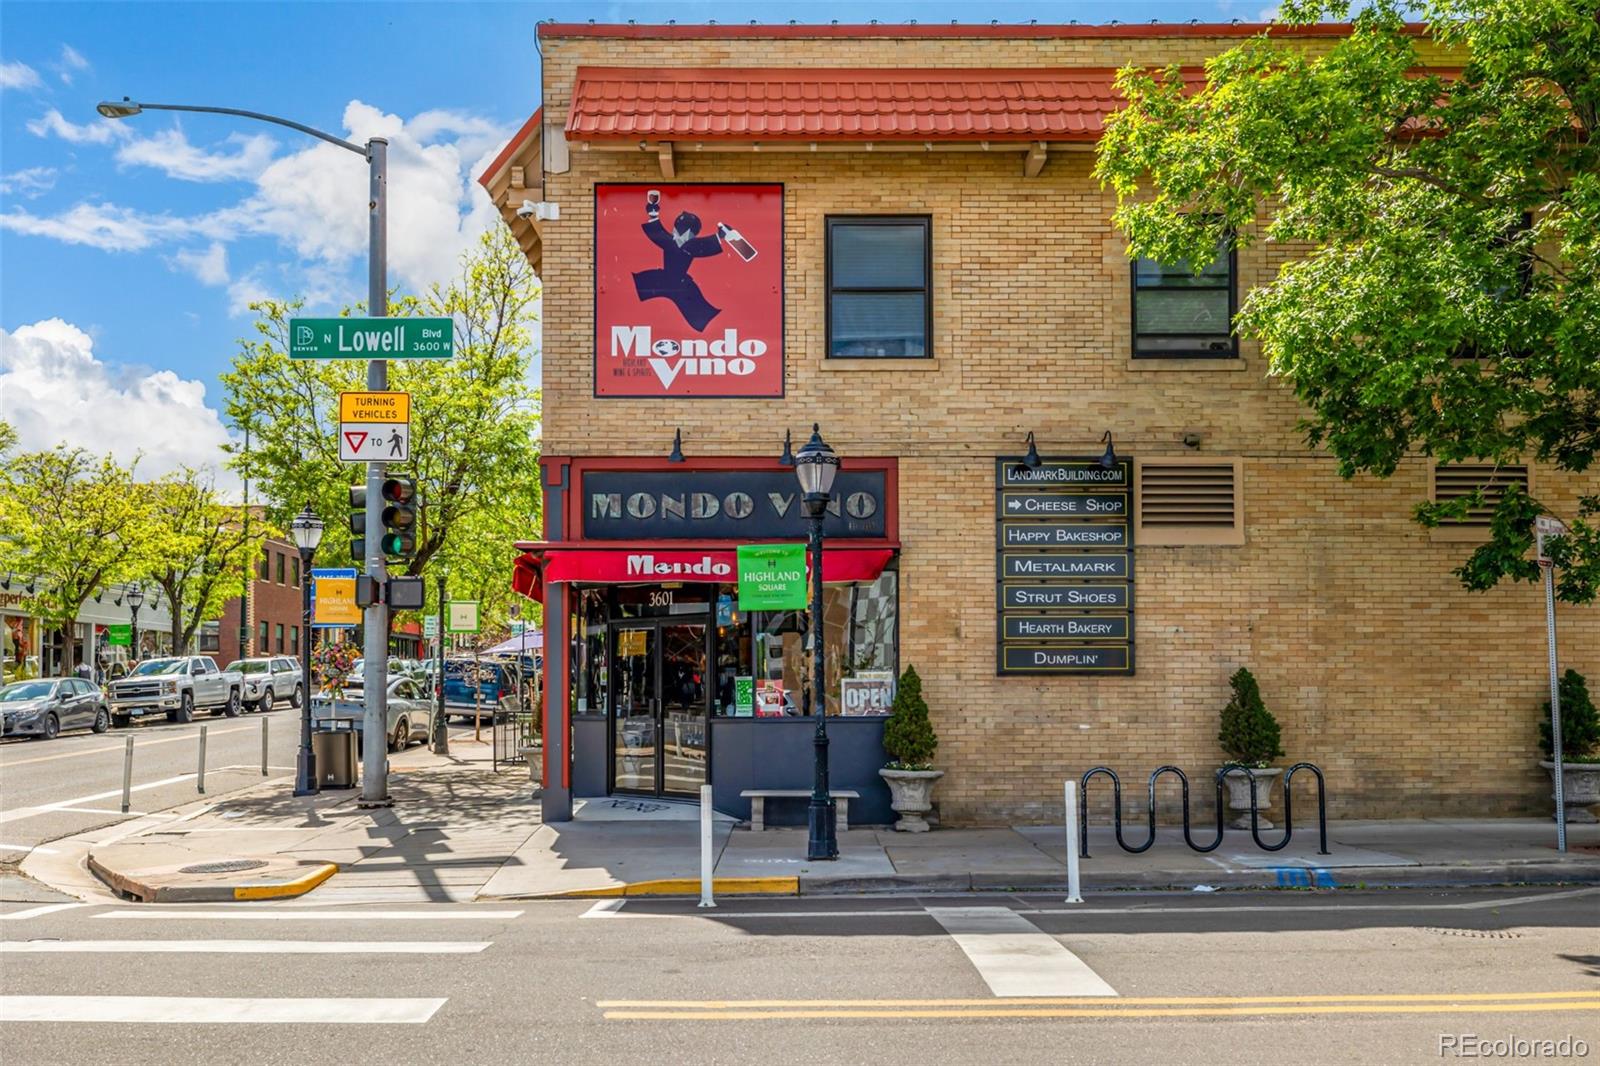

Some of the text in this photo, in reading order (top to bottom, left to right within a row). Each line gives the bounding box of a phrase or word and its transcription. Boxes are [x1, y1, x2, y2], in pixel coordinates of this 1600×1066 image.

[324, 325, 442, 352] N Lowell Blvd
[611, 325, 768, 357] Mondo
[413, 342, 450, 351] 3600 W
[355, 398, 395, 407] TURNING
[352, 410, 398, 419] VEHICLES
[371, 438, 383, 447] TO
[592, 492, 754, 519] MONDO
[1025, 499, 1122, 511] CHEESE SHOP
[1008, 530, 1122, 541] HAPPY BAKESHOP
[627, 555, 731, 576] Mondo
[1015, 560, 1116, 572] METALMARK
[744, 571, 801, 583] HIGHLAND
[758, 584, 787, 592] SQUARE
[648, 591, 673, 607] 3601
[1015, 591, 1116, 603] STRUT SHOES
[1019, 621, 1112, 634] HEARTH BAKERY
[1034, 651, 1098, 665] DUMPLIN'
[846, 688, 892, 708] OPEN
